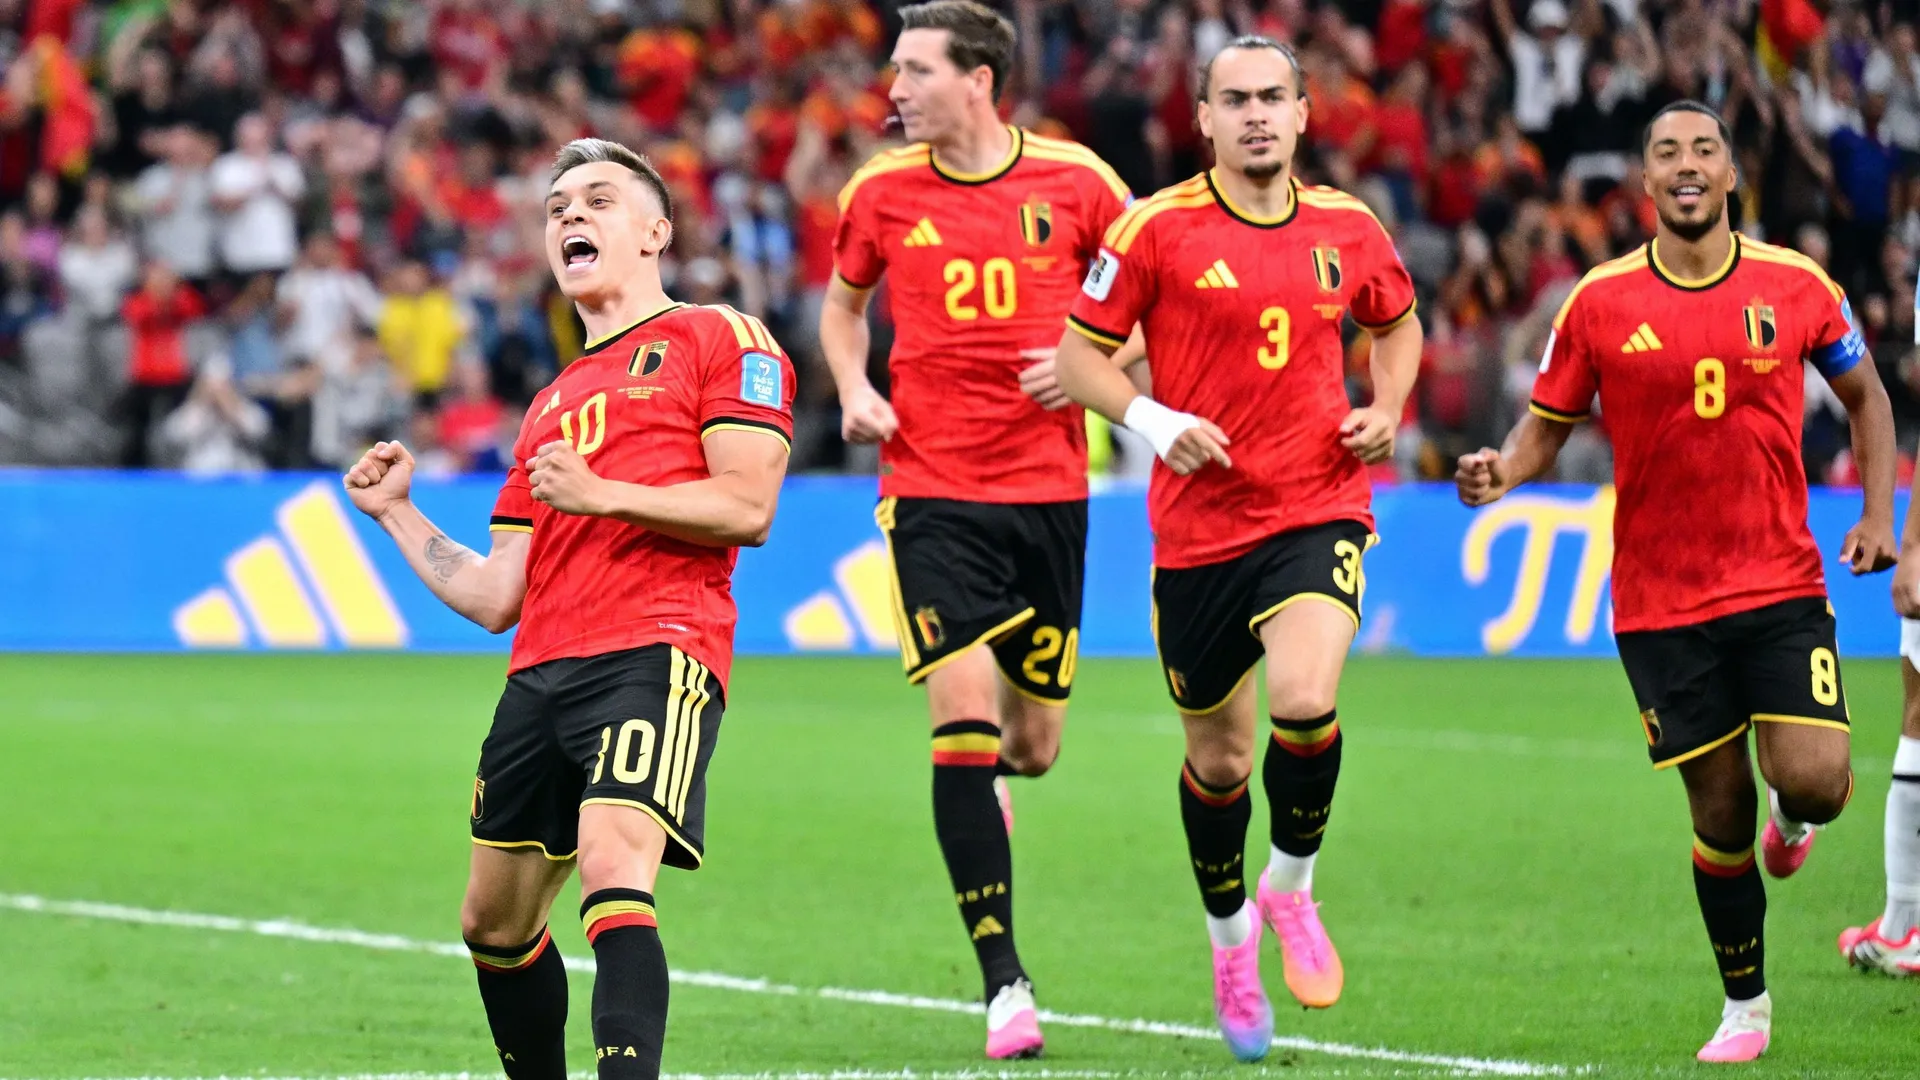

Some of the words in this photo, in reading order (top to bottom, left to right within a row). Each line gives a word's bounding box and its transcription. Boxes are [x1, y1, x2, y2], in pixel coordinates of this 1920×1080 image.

[943, 257, 1017, 320] 20
[1257, 306, 1290, 369] 3
[1694, 357, 1726, 419] 8
[561, 392, 607, 455] 10
[1332, 539, 1362, 595] 3
[1022, 625, 1079, 688] 20
[1810, 646, 1838, 706] 8
[592, 718, 656, 784] 10
[596, 1046, 637, 1062] BFA
